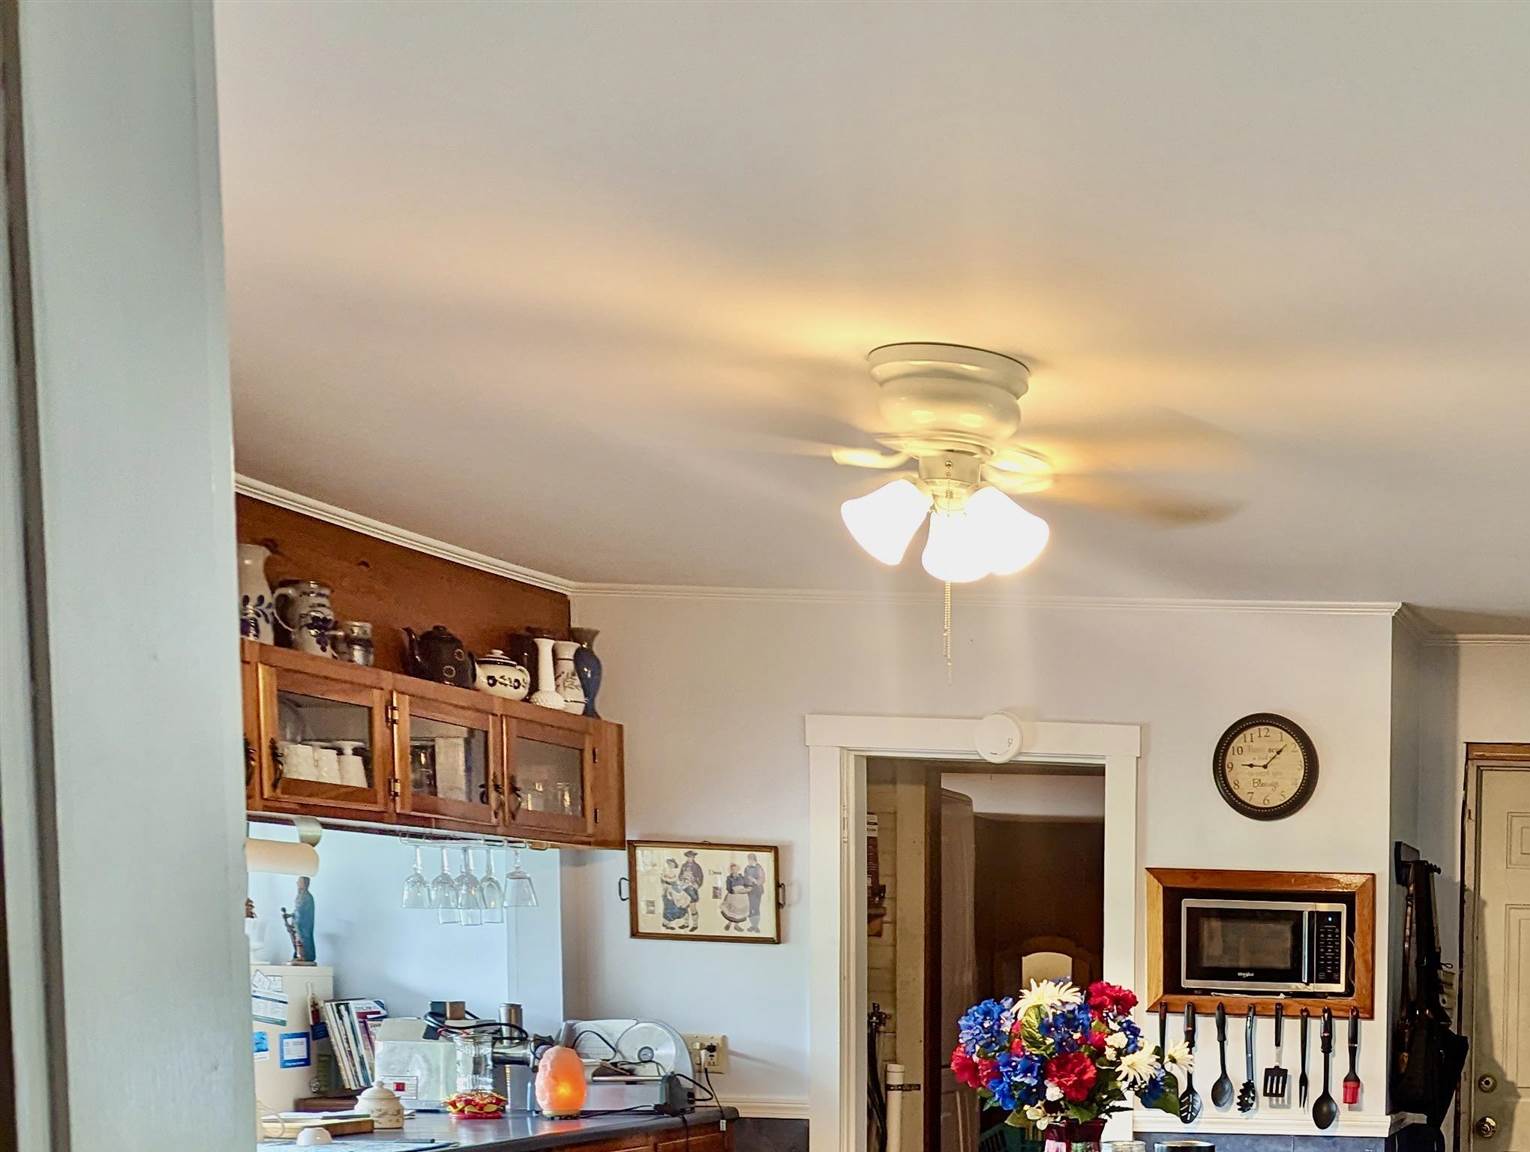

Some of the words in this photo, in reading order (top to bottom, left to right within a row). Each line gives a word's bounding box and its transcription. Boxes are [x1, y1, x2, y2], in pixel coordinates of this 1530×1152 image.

[1243, 733, 1254, 743] 11
[1258, 728, 1270, 738] 12
[1232, 746, 1243, 756] 10
[1227, 762, 1234, 772] 9
[1233, 780, 1240, 790] 8
[1247, 792, 1254, 802] 7
[1263, 796, 1270, 805] 6
